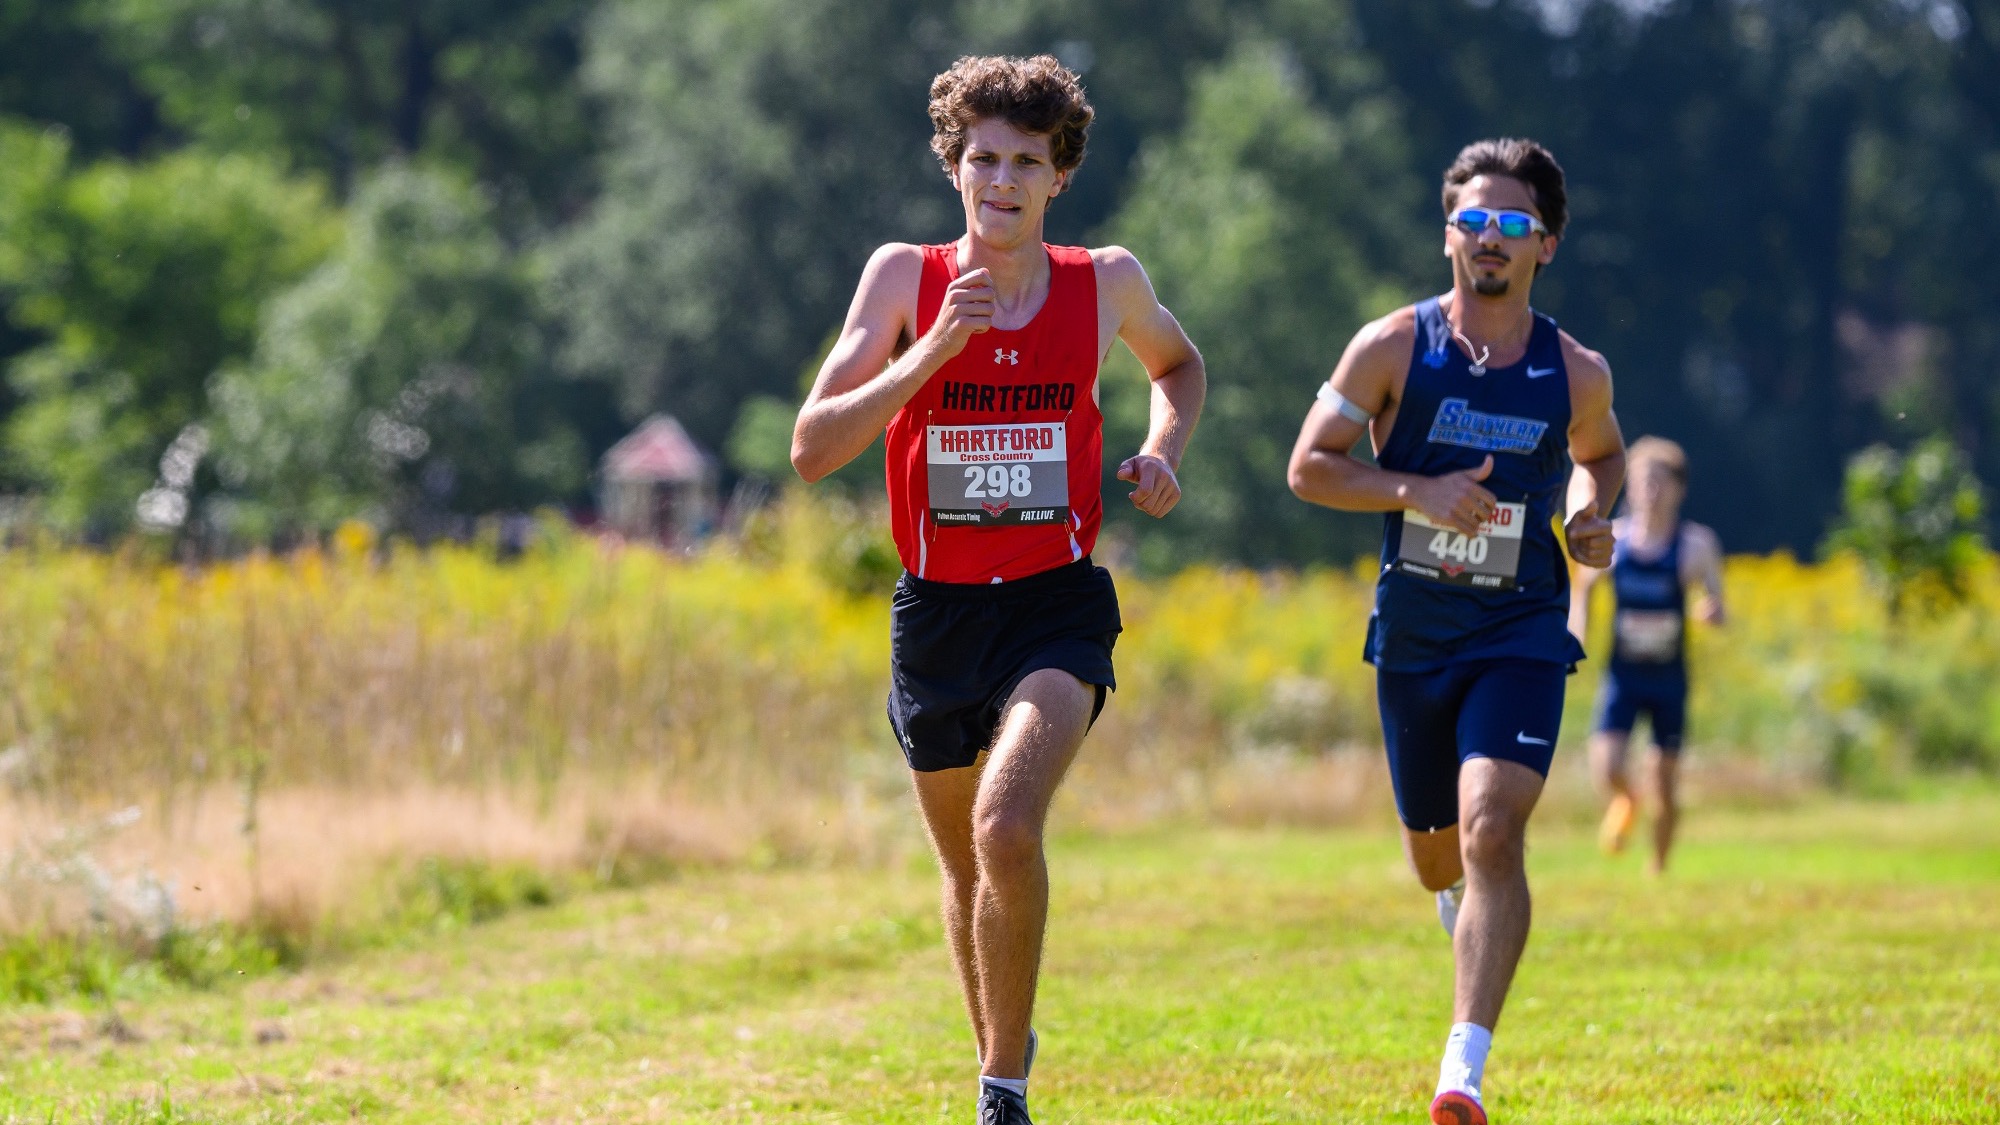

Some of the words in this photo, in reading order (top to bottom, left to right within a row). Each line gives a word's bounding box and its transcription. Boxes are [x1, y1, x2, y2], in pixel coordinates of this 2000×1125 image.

[942, 381, 1075, 412] HARTFORD
[940, 428, 1054, 452] HARTFORD
[960, 454, 990, 462] Cross
[993, 452, 1033, 461] Country
[964, 464, 1032, 498] 298
[1020, 510, 1055, 520] FAT.LIVE
[1428, 531, 1488, 565] 440
